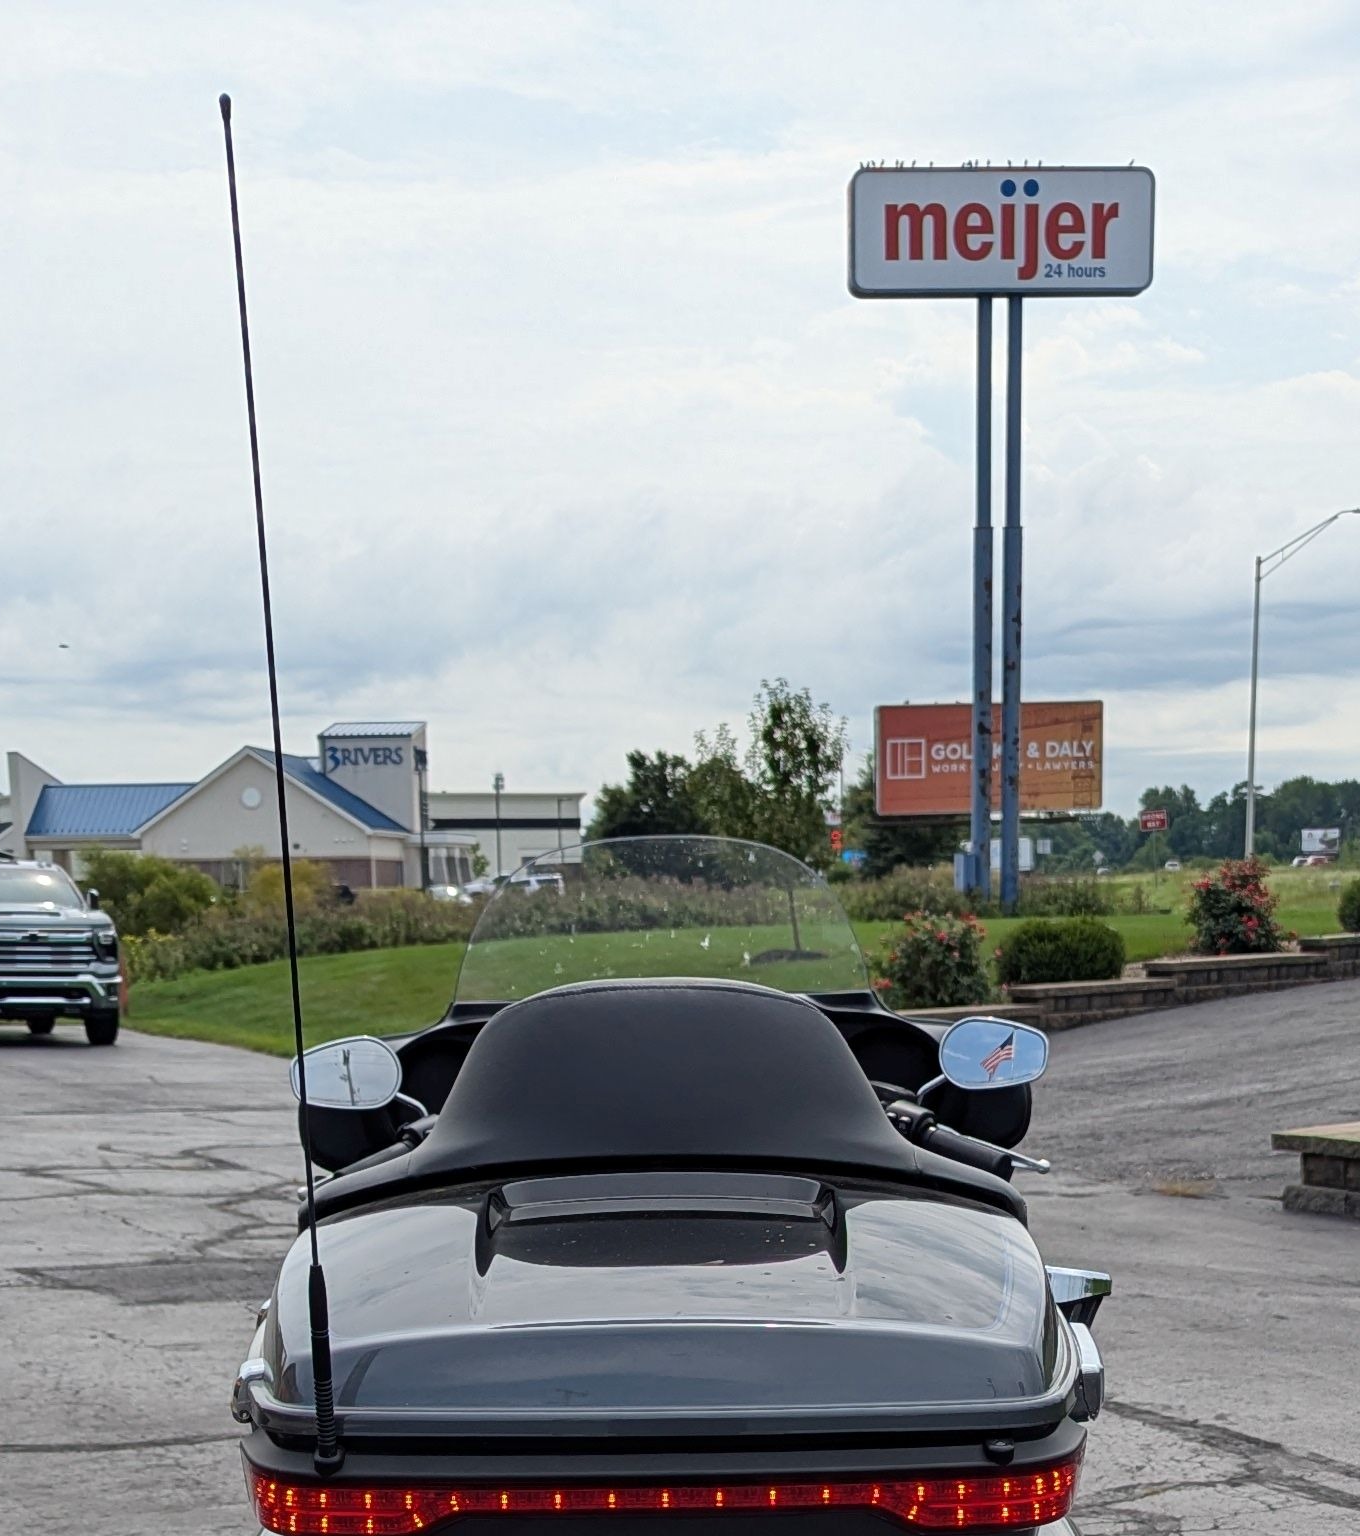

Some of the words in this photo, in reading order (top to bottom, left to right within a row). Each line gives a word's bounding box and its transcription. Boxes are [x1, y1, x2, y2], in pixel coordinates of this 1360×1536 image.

[884, 178, 1120, 281] meijer
[1043, 263, 1063, 278] 24
[1067, 262, 1106, 278] hours
[931, 742, 1017, 761] GOLK
[1026, 741, 1039, 759] &
[1045, 740, 1094, 758] DALY
[931, 762, 966, 773] WORK
[1036, 760, 1095, 772] LAWYERS
